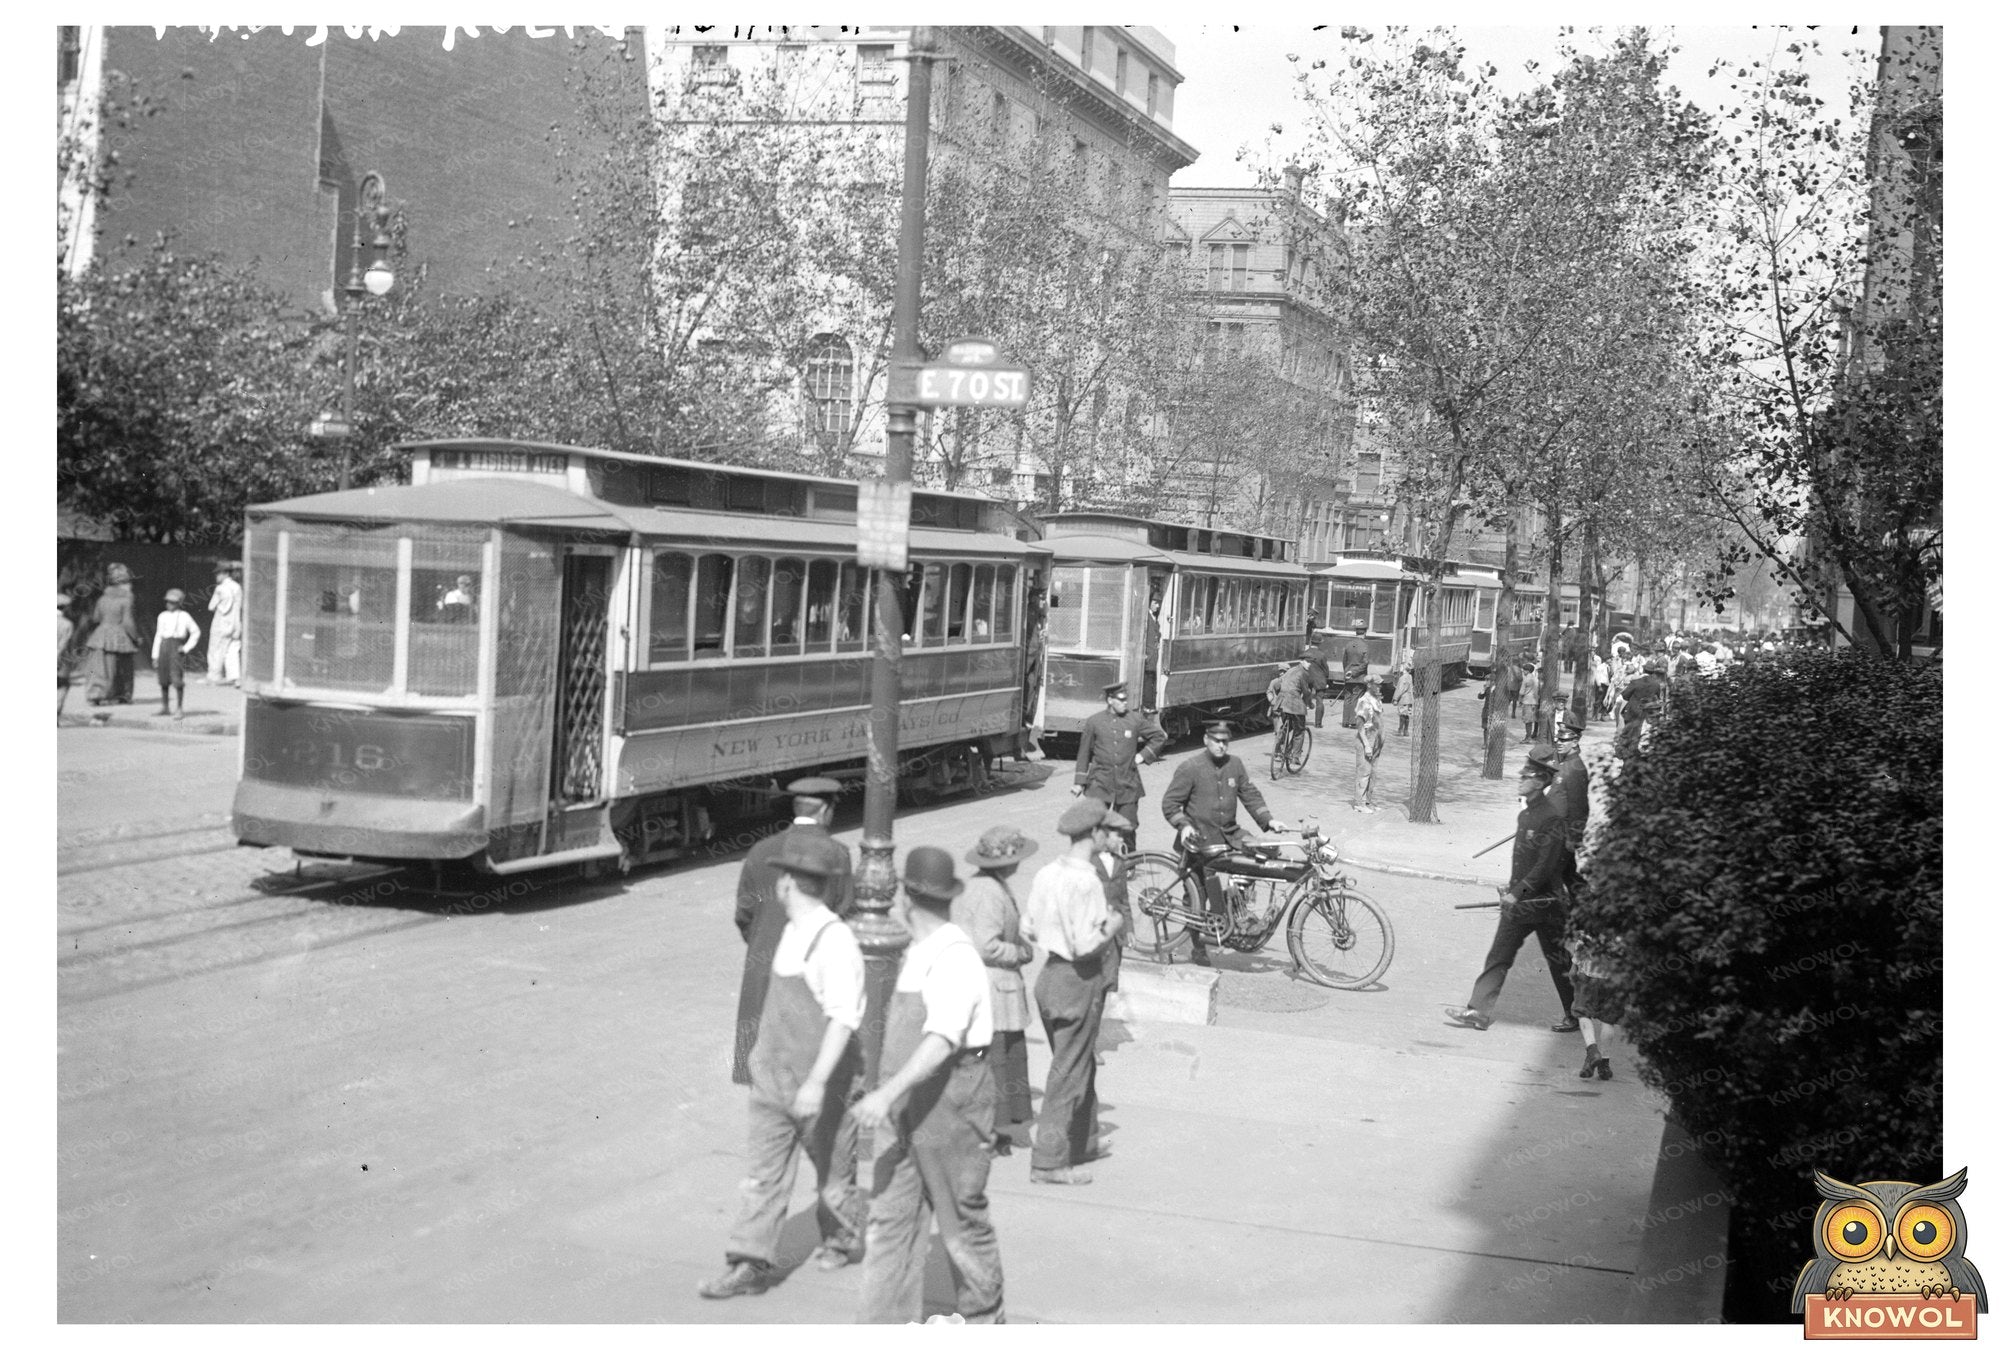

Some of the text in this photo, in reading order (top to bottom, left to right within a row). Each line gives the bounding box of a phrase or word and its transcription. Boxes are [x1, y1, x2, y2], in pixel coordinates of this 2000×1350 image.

[948, 371, 988, 400] 70
[711, 737, 761, 758] NEW
[774, 728, 832, 749] YORK
[842, 714, 930, 740] RAAYS
